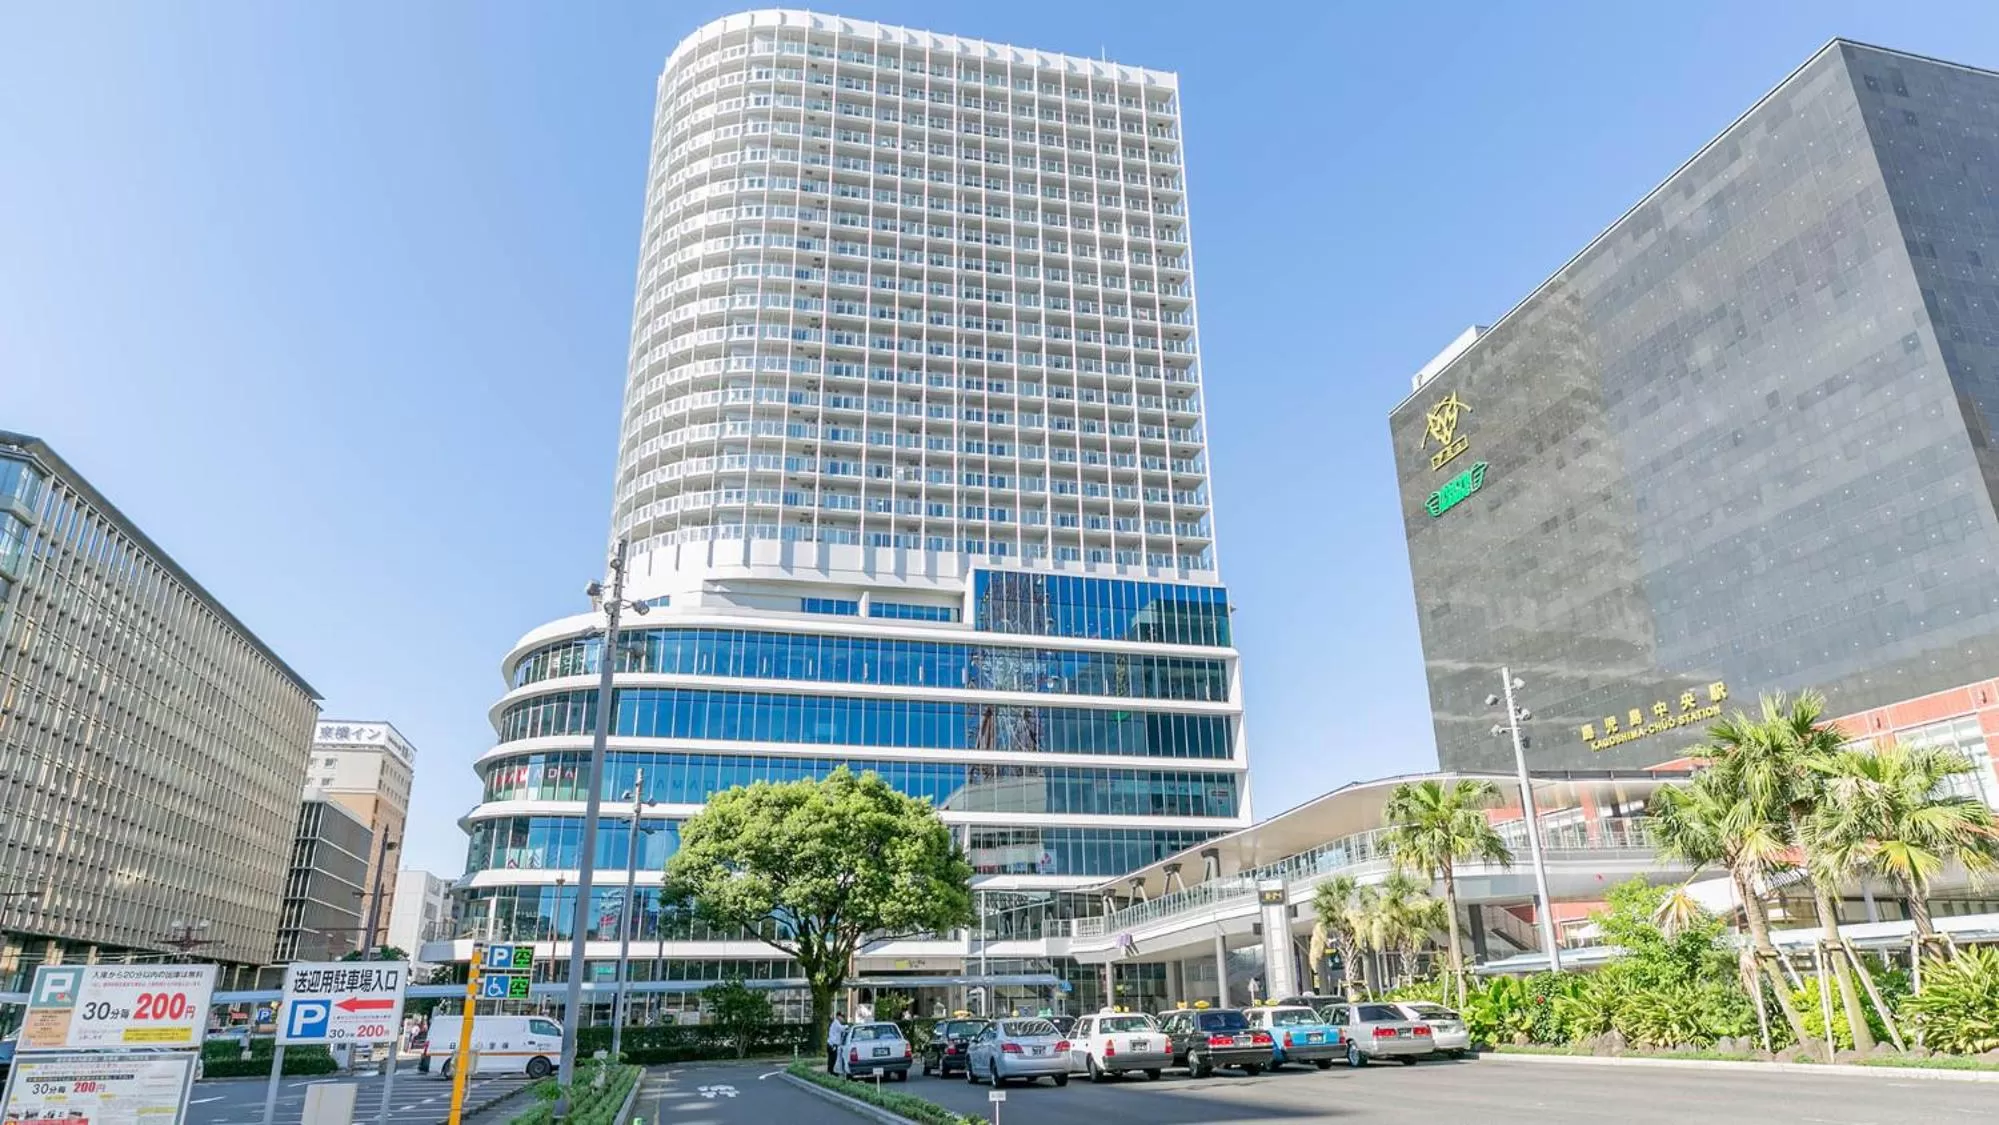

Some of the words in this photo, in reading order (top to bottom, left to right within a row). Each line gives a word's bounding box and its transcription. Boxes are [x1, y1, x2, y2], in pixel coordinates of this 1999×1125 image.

[1678, 704, 1722, 726] STATION
[493, 948, 508, 966] P
[293, 970, 398, 993] 送迎用駐車場入口
[132, 992, 196, 1020] 200円
[291, 1004, 326, 1036] P
